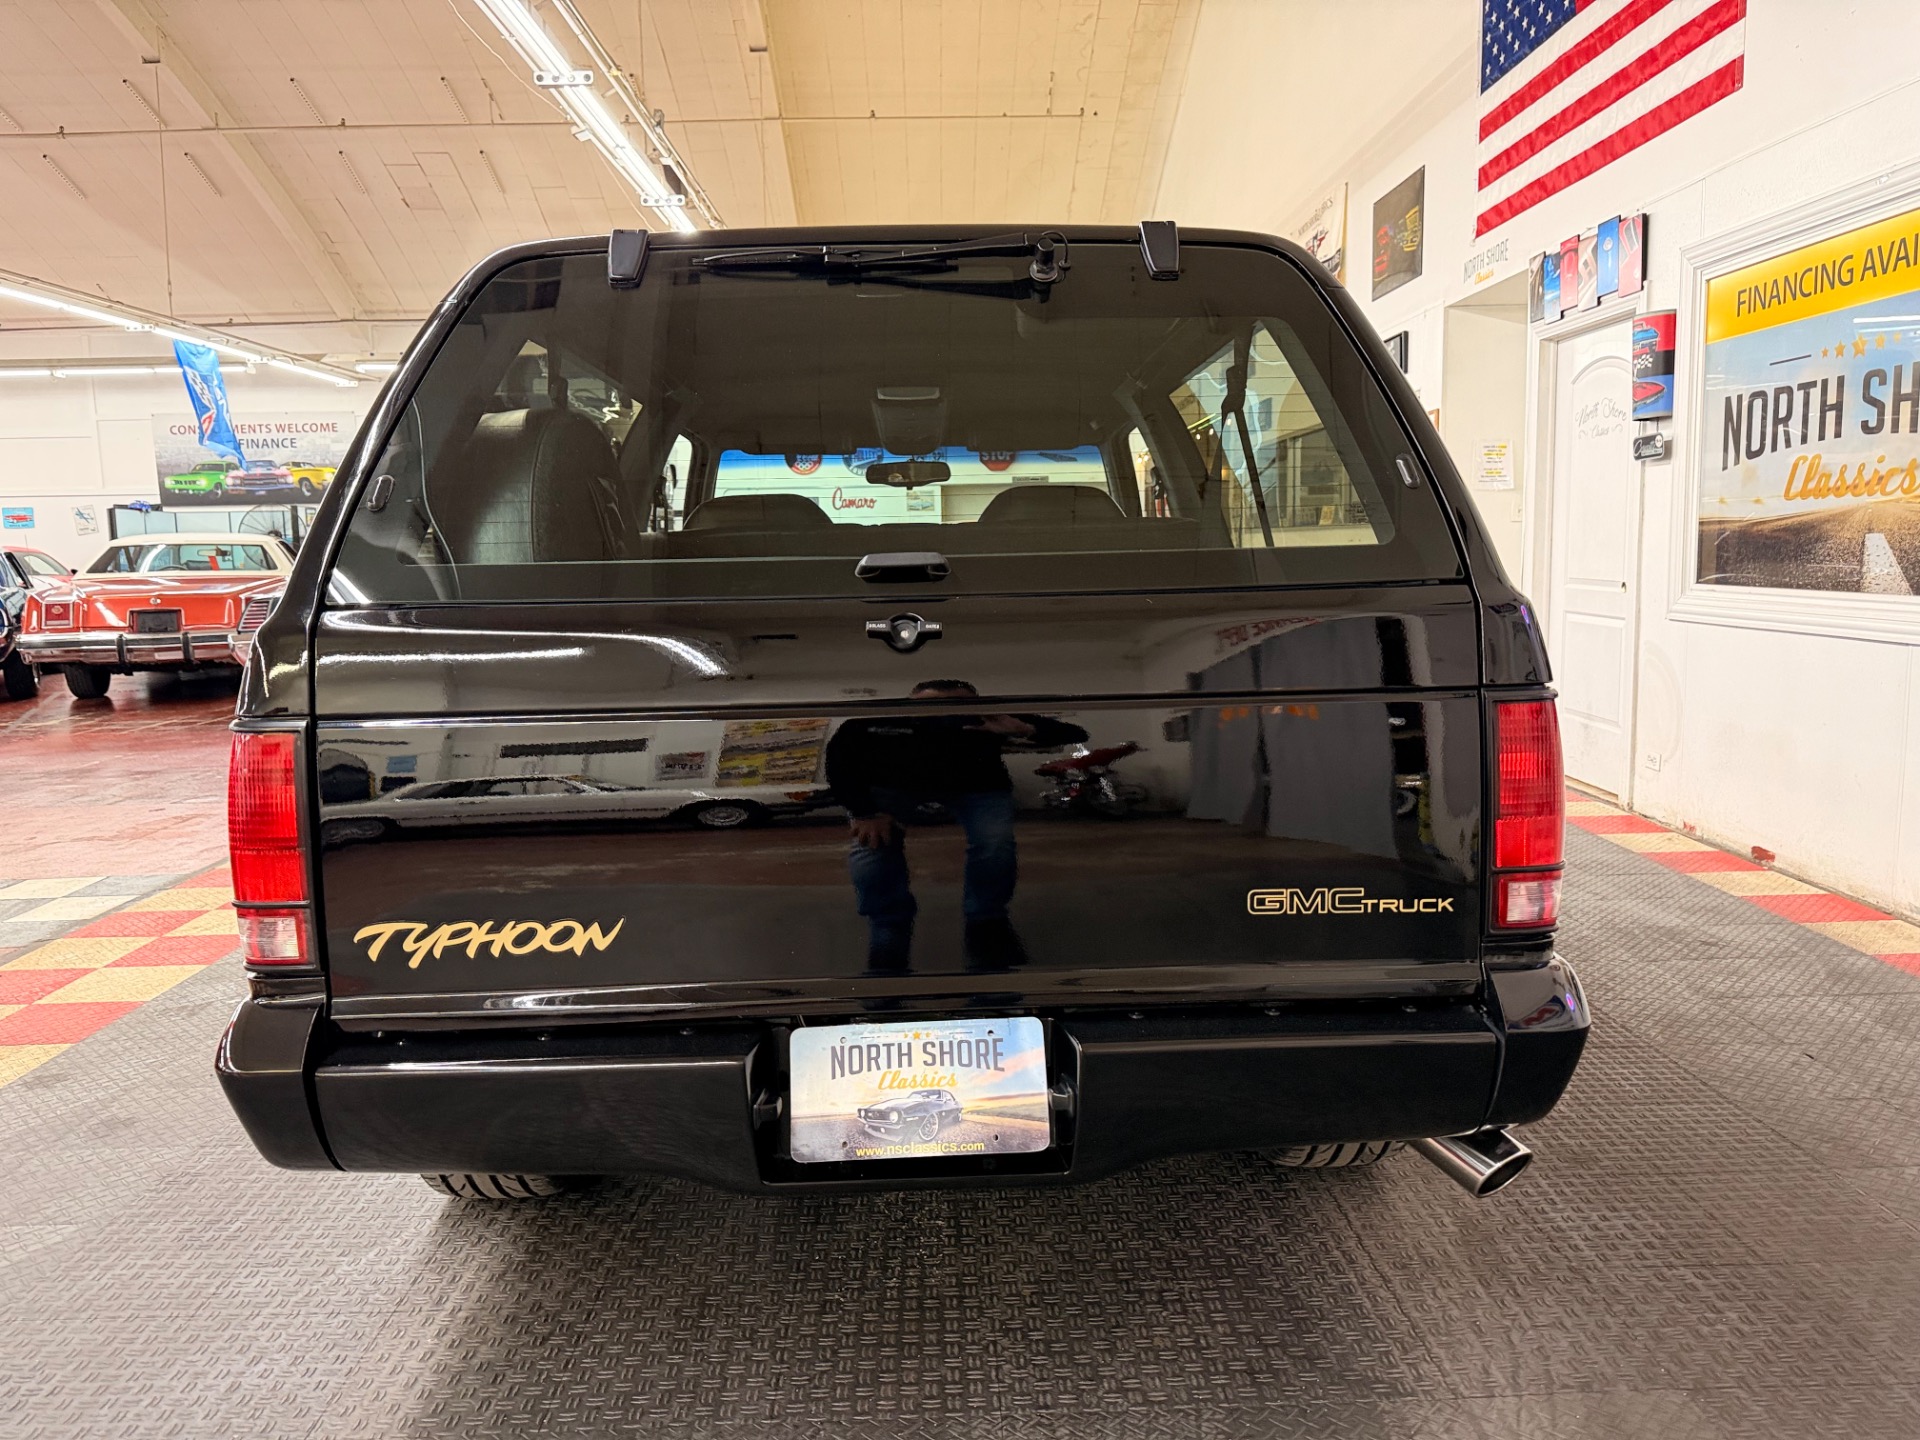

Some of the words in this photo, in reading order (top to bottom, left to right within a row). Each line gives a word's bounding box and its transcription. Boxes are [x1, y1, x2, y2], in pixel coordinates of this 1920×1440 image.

[1463, 251, 1485, 284] NORTH
[1486, 238, 1509, 266] SHORE
[1736, 253, 1855, 319] FINANCING
[1859, 231, 1920, 283] AVAI
[169, 423, 272, 436] CONMENTS
[275, 422, 338, 434] WELCOME
[1721, 374, 1846, 472] NORTH
[1860, 360, 1920, 435] SH
[238, 437, 297, 449] FINANCE
[1782, 453, 1920, 501] Classics
[832, 487, 877, 510] Camaro
[1247, 887, 1365, 915] GMC
[1361, 898, 1454, 912] TRUCK
[353, 916, 625, 970] TYPHOON
[830, 1041, 912, 1081] NORTH
[922, 1037, 1006, 1073] SHORE
[877, 1069, 959, 1091] Classics
[856, 1141, 985, 1157] www.nsclassics.com
